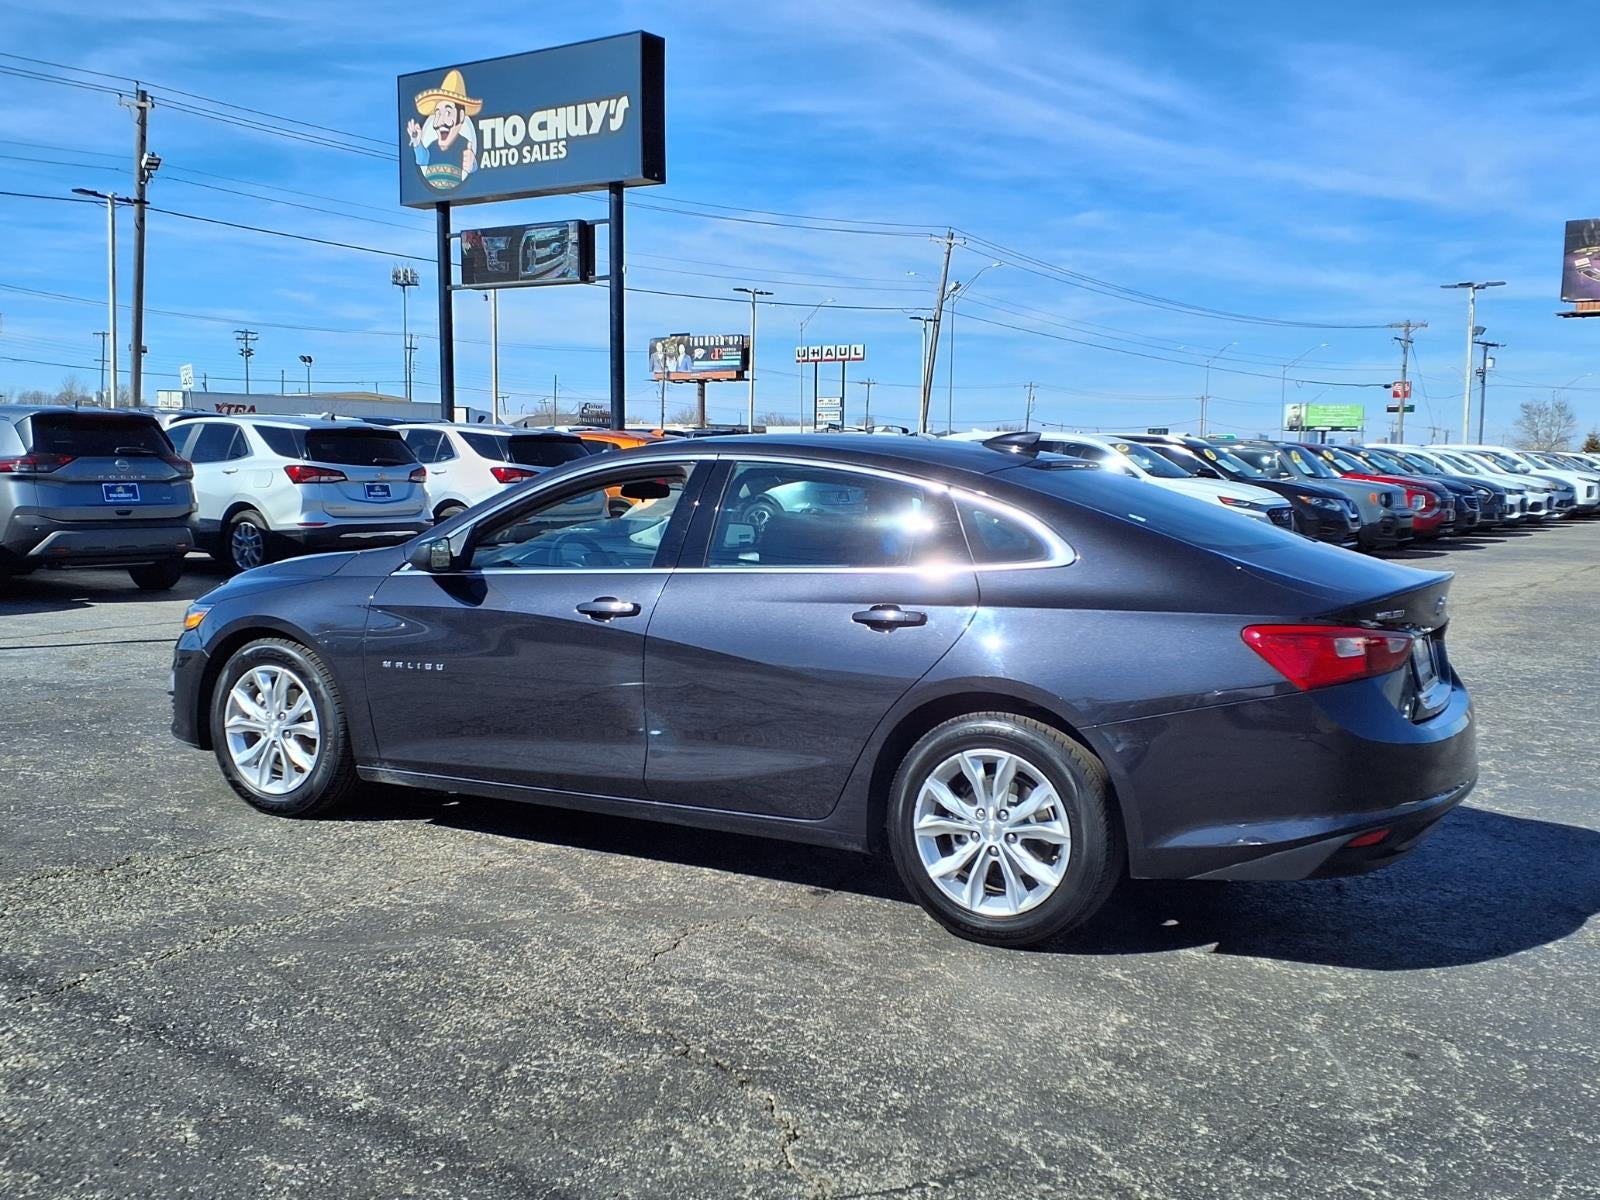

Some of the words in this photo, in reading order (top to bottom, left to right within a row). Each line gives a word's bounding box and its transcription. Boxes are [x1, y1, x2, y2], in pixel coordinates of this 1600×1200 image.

[478, 114, 526, 149] TIO
[528, 95, 630, 142] CHUY'S
[480, 149, 519, 169] AUTO
[522, 140, 568, 164] SALES
[182, 375, 193, 385] 40
[382, 660, 444, 671] MALIBU
